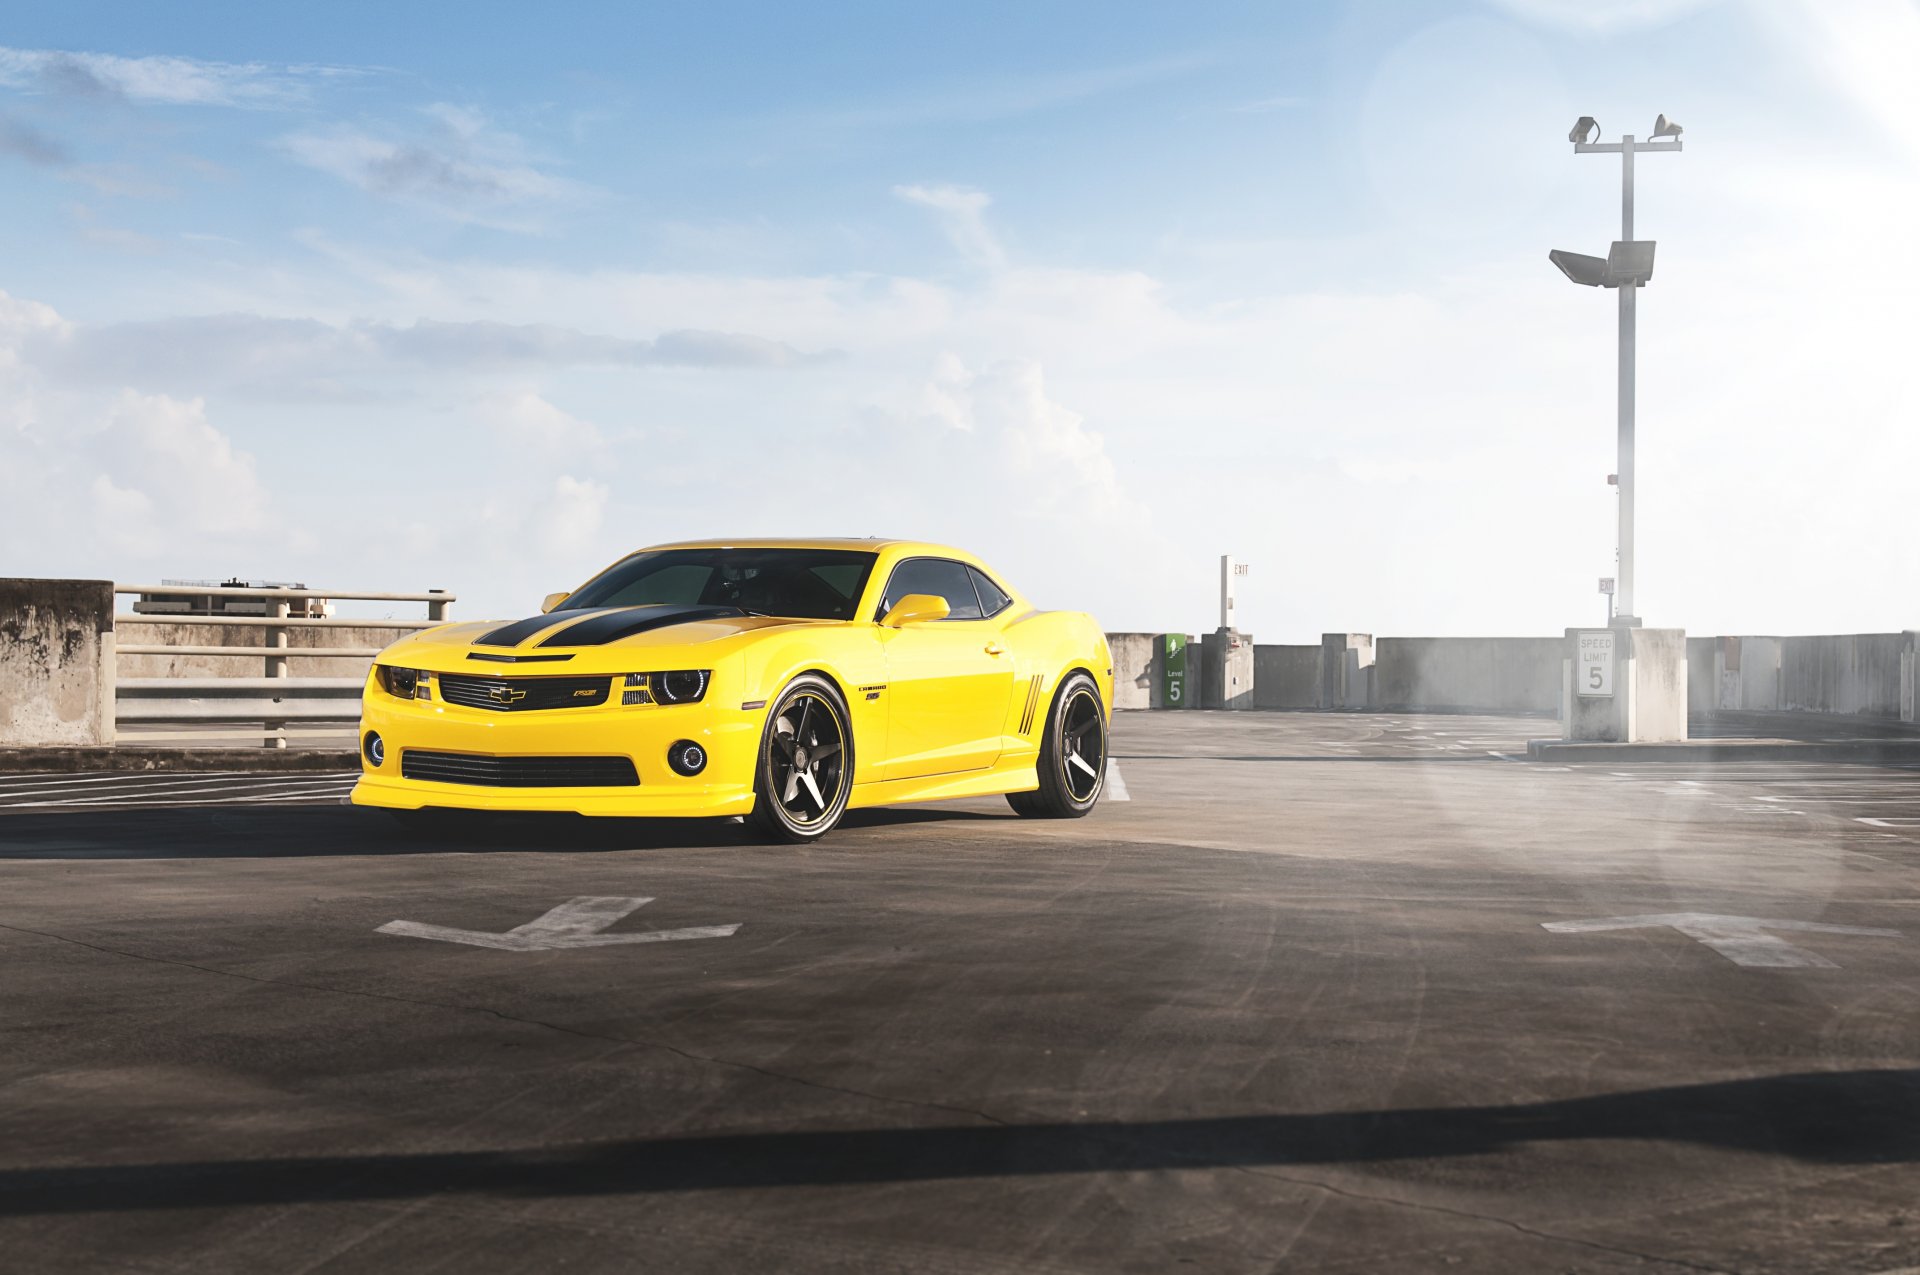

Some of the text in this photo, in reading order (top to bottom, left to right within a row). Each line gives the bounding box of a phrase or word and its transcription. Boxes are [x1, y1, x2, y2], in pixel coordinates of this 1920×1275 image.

[1234, 564, 1249, 575] EXIT
[1600, 579, 1615, 592] EXIT
[1581, 639, 1612, 649] SPEED
[1584, 653, 1608, 662] LIMIT
[1589, 667, 1603, 689] 5
[1170, 681, 1181, 701] 5
